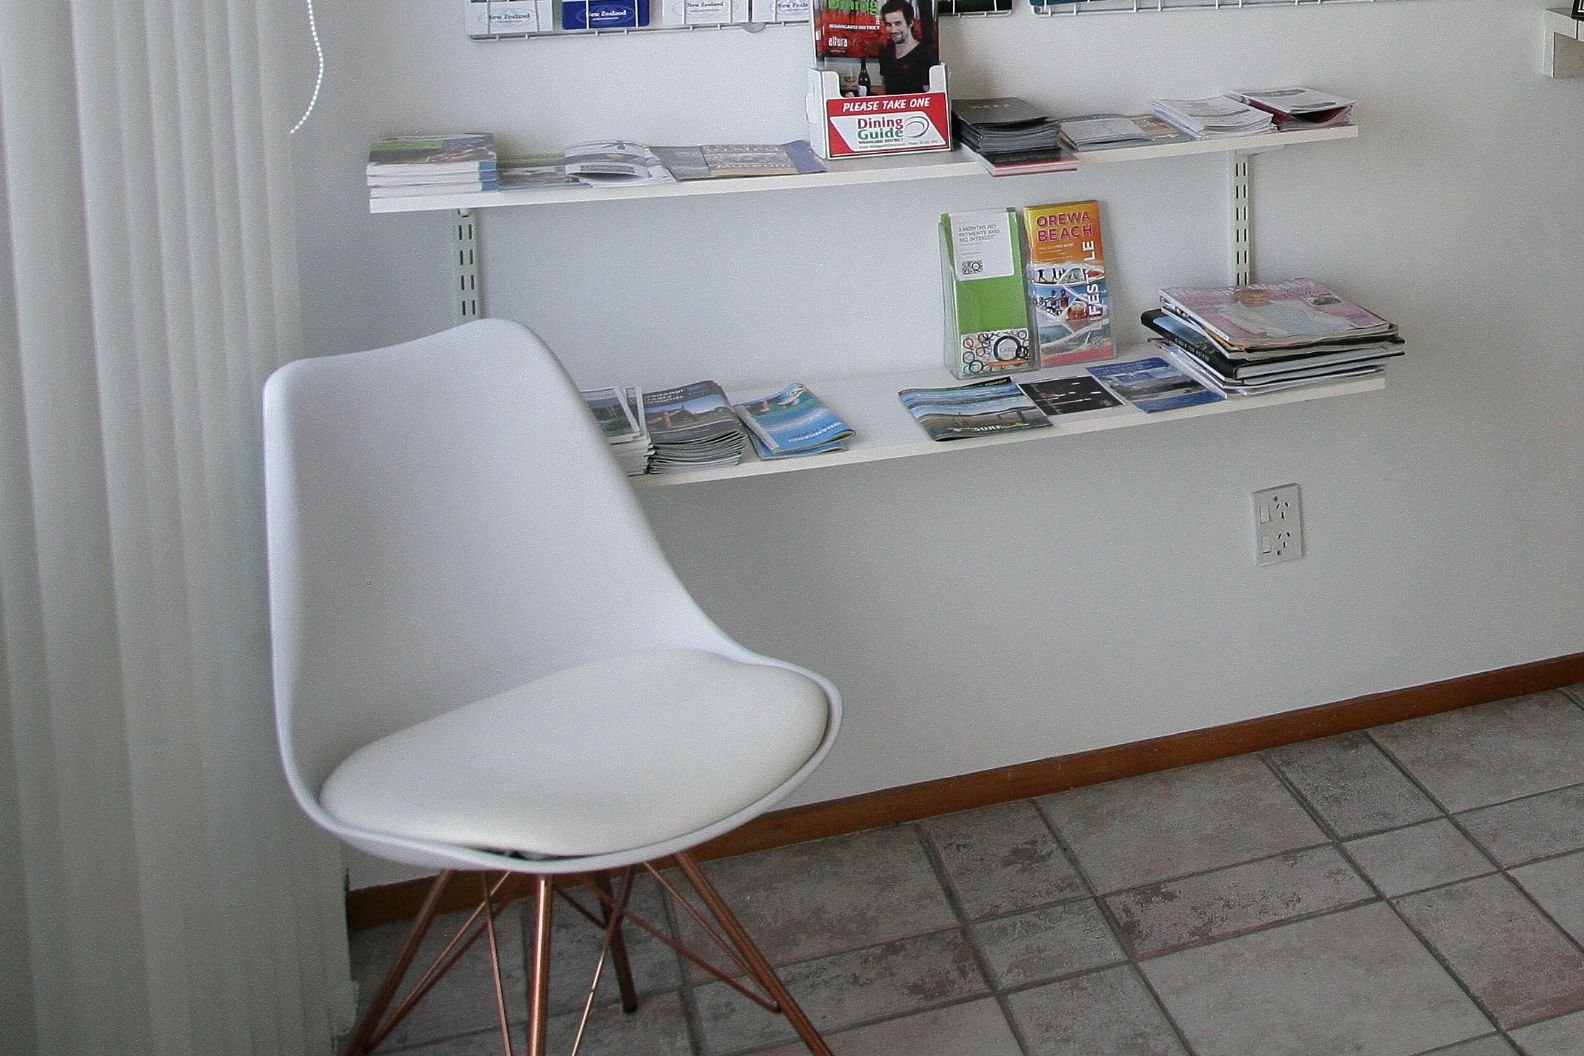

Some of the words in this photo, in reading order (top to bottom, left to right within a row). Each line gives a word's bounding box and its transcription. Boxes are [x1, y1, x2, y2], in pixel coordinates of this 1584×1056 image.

[843, 101, 879, 112] PLEASE
[882, 100, 906, 109] TAKE
[910, 98, 930, 107] ONE
[857, 116, 903, 131] Dining
[857, 127, 903, 139] Guide
[1037, 211, 1090, 227] OREWA
[1037, 224, 1093, 242] BEACH
